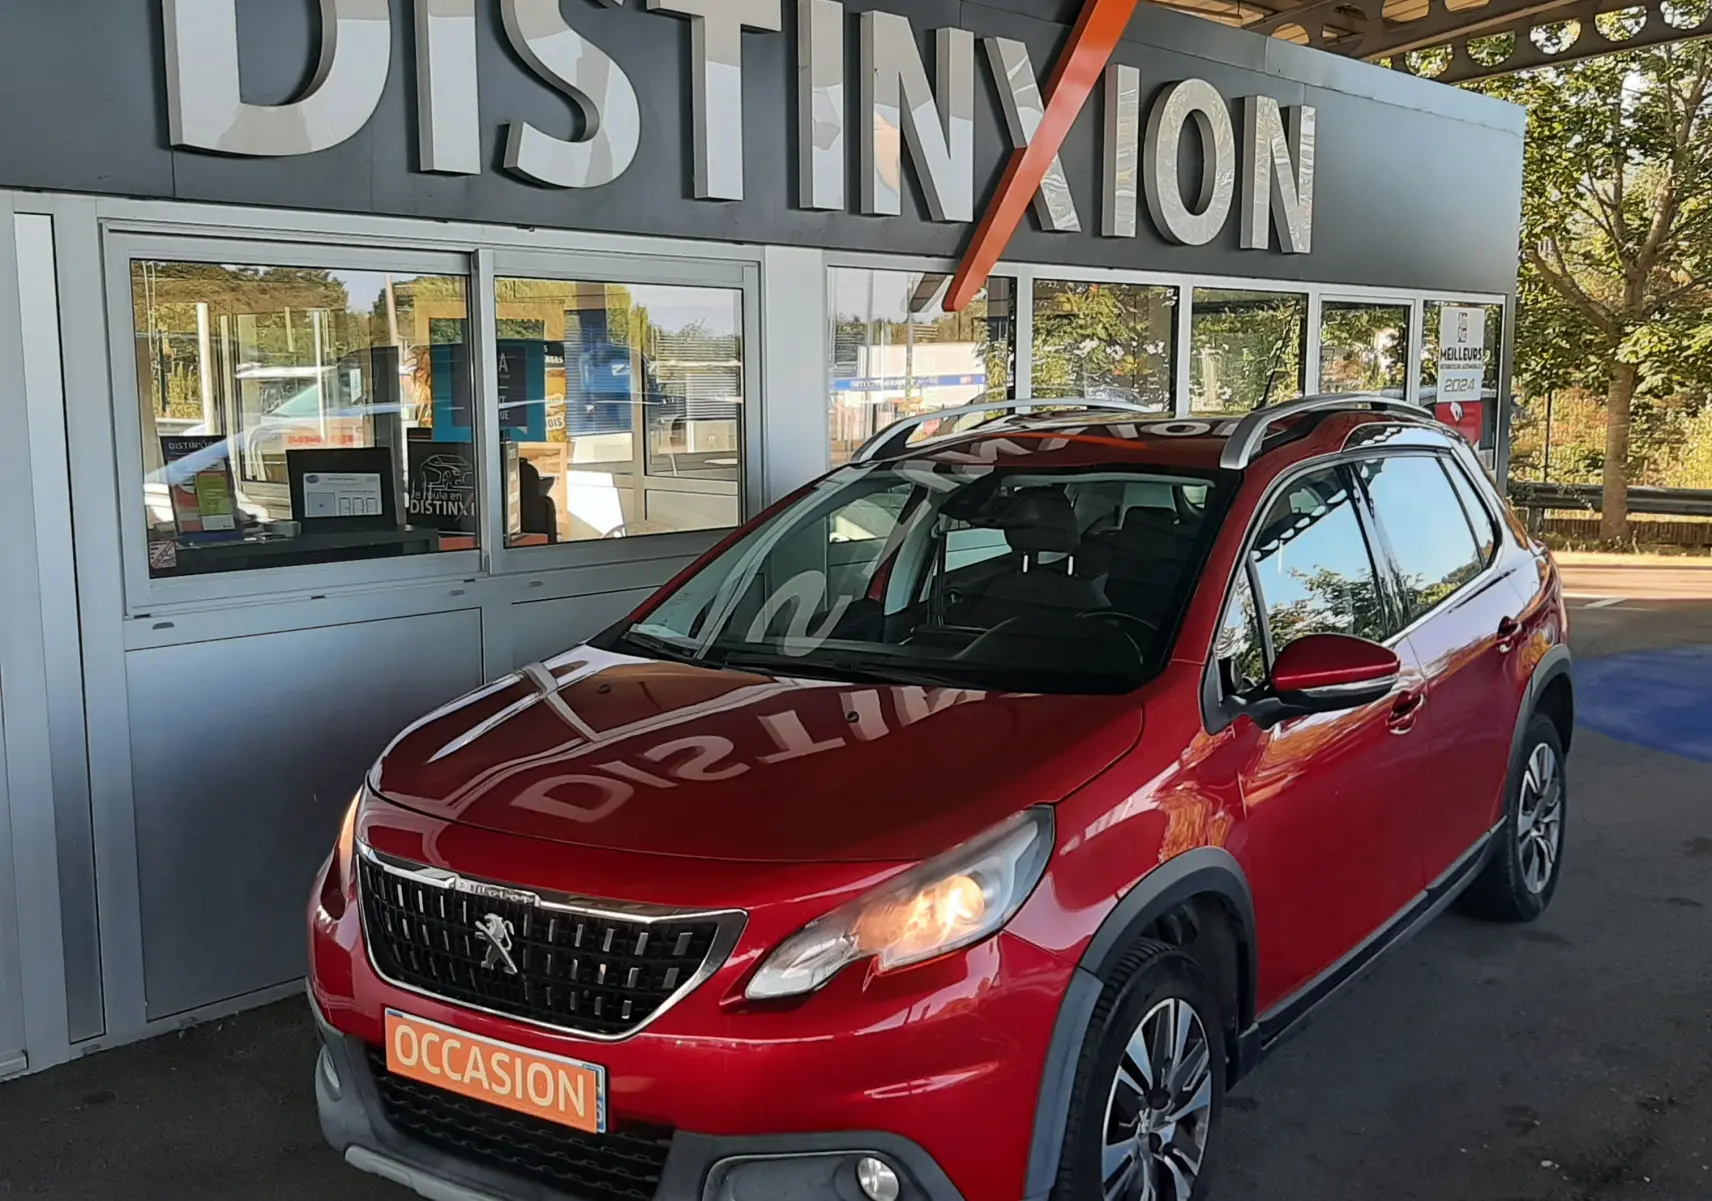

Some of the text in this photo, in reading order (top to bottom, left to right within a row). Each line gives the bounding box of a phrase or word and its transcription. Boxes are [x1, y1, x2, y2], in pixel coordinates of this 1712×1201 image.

[161, 0, 1317, 310] DISTINXION
[1440, 347, 1482, 361] MEILLEURS
[1443, 379, 1475, 392] 2024
[394, 1024, 586, 1118] OCCASION
